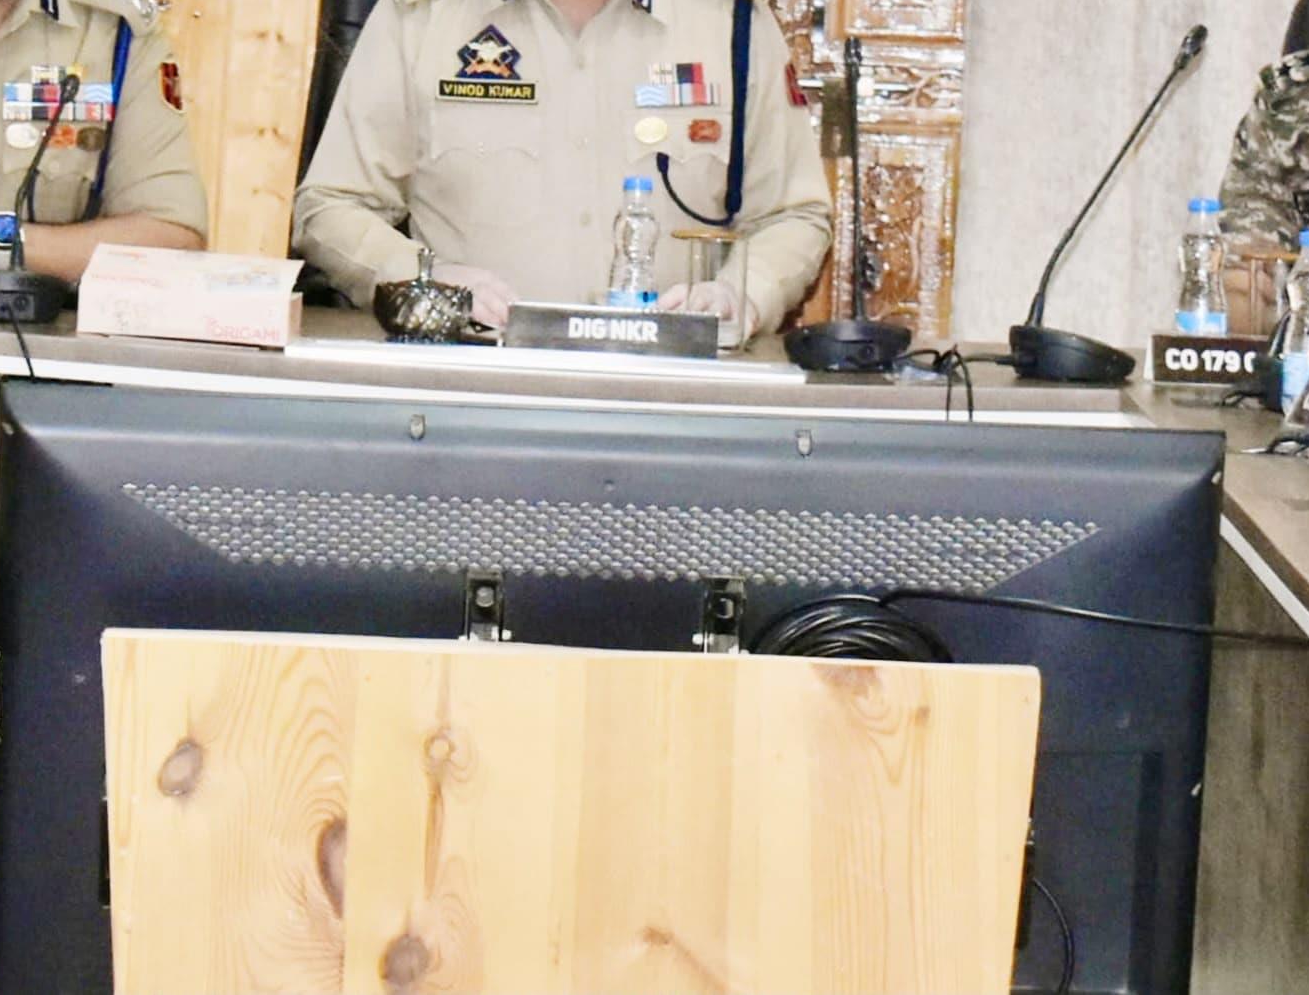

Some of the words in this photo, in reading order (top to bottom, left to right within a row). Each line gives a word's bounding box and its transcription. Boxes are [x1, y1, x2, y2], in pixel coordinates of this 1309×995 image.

[443, 83, 484, 97] VINOD
[488, 85, 532, 98] KUMAR
[567, 317, 607, 338] DIG
[610, 318, 659, 343] NKR
[1165, 348, 1198, 371] CO
[1201, 349, 1238, 373] 179
